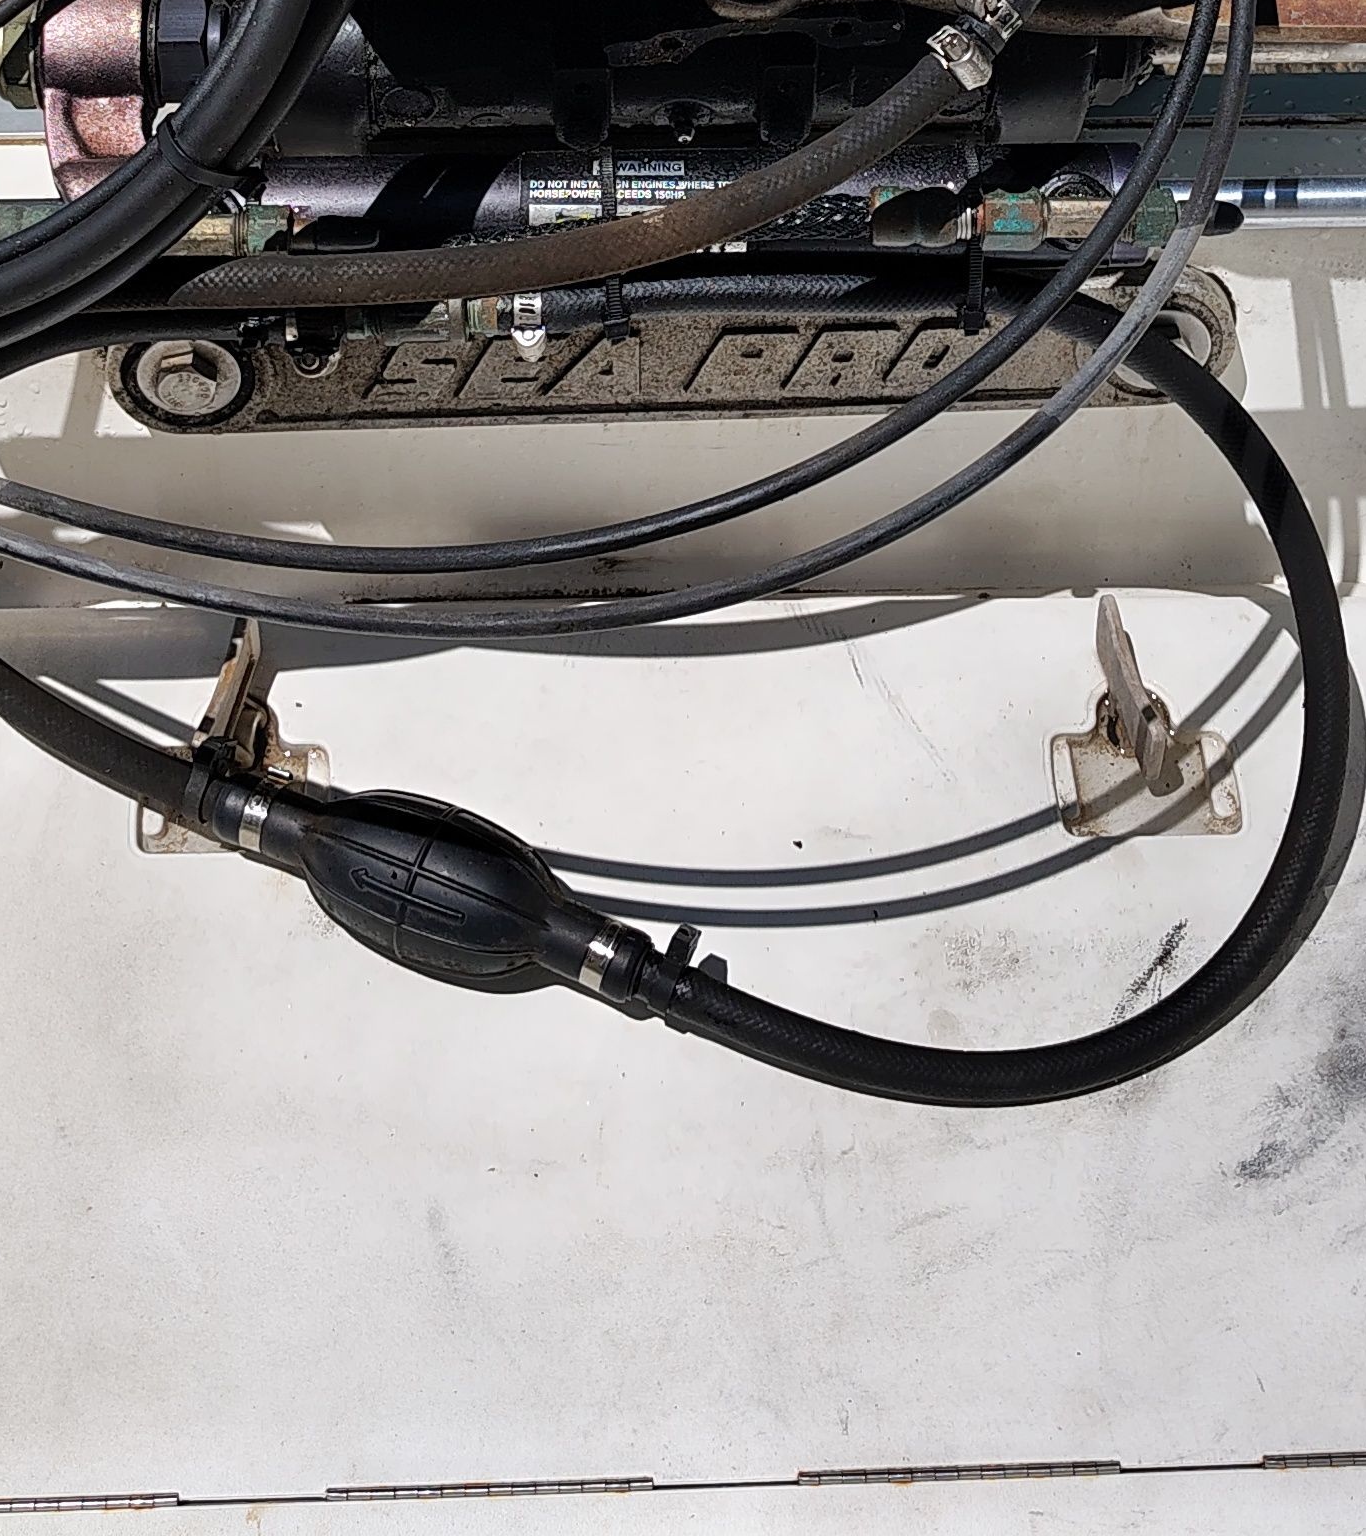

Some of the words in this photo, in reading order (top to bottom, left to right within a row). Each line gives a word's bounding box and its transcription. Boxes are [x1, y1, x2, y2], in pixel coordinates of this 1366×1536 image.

[529, 180, 545, 189] DO
[547, 180, 568, 189] NOT
[631, 180, 676, 190] ENGINES
[677, 180, 715, 190] WHERE
[529, 189, 602, 199] HORSEPOWER
[362, 326, 641, 399] SEA
[683, 318, 975, 393] PRO
